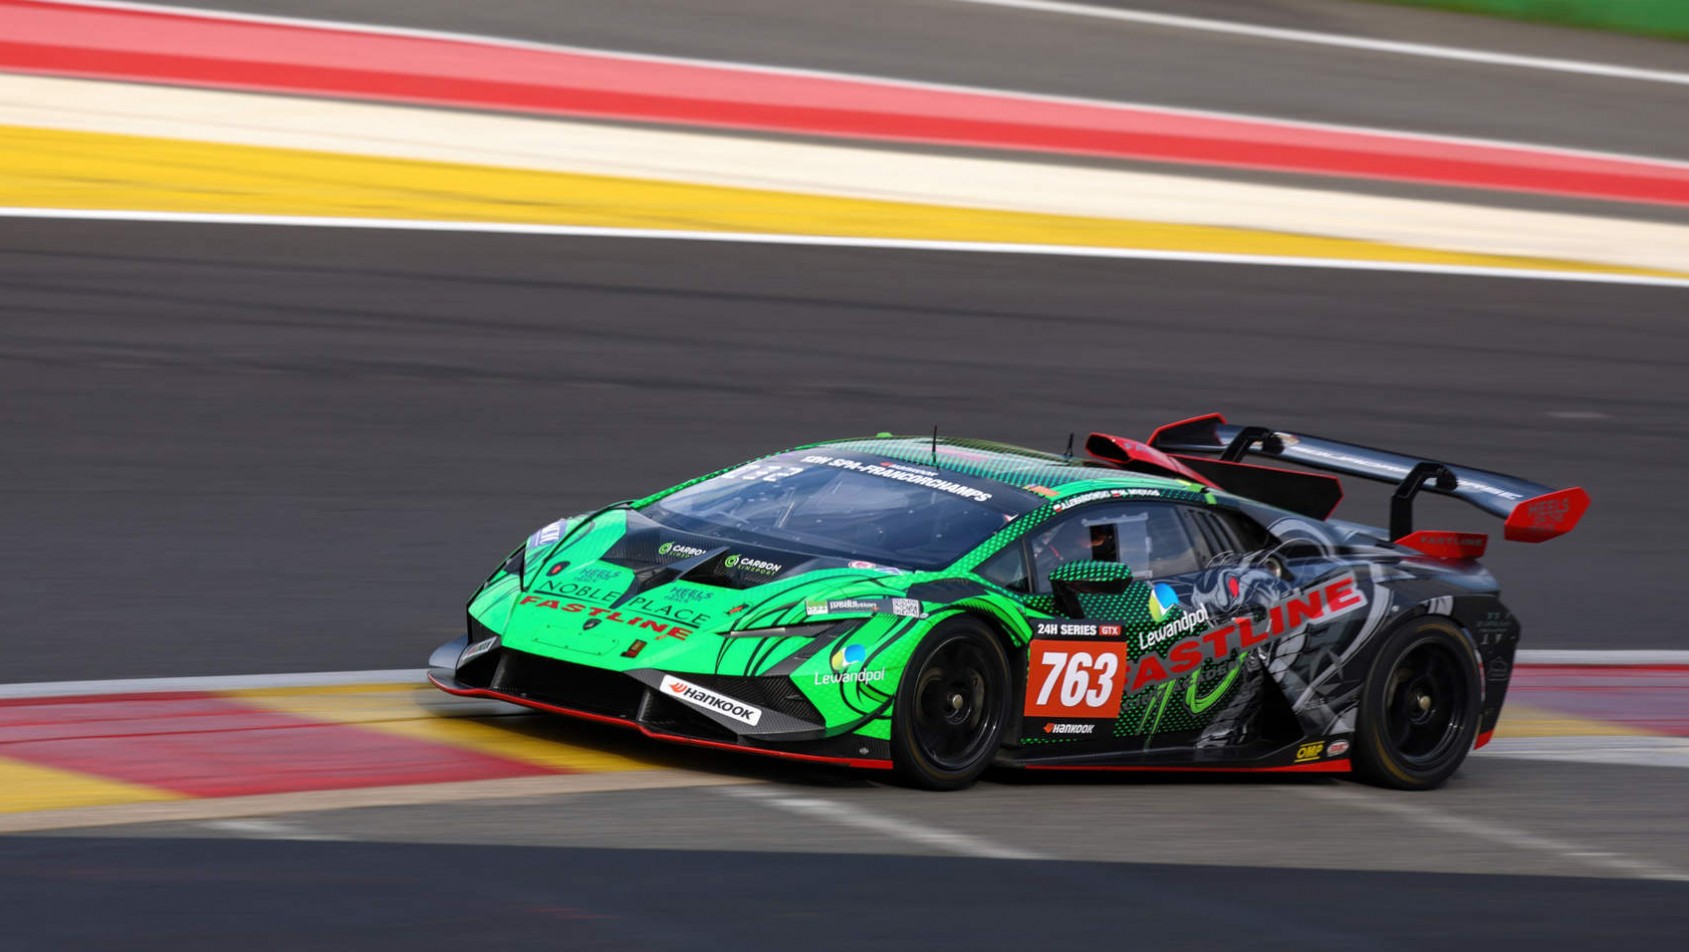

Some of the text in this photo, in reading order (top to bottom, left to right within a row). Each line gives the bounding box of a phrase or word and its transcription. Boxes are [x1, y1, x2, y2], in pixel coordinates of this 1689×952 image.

[829, 458, 992, 502] SPA-FRANCORCHAMPS
[672, 544, 706, 556] CARBO
[740, 558, 782, 572] CARBON
[520, 595, 693, 641] FASTLINE
[540, 580, 711, 624] NOBLE PLACE
[1037, 623, 1119, 636] 24H SERIES GTX
[1125, 576, 1362, 691] ASTLINE
[1139, 602, 1209, 650] Lewandpol
[814, 667, 886, 685] Lewandpol
[1035, 651, 1119, 707] 763
[1296, 743, 1324, 759] OMP
